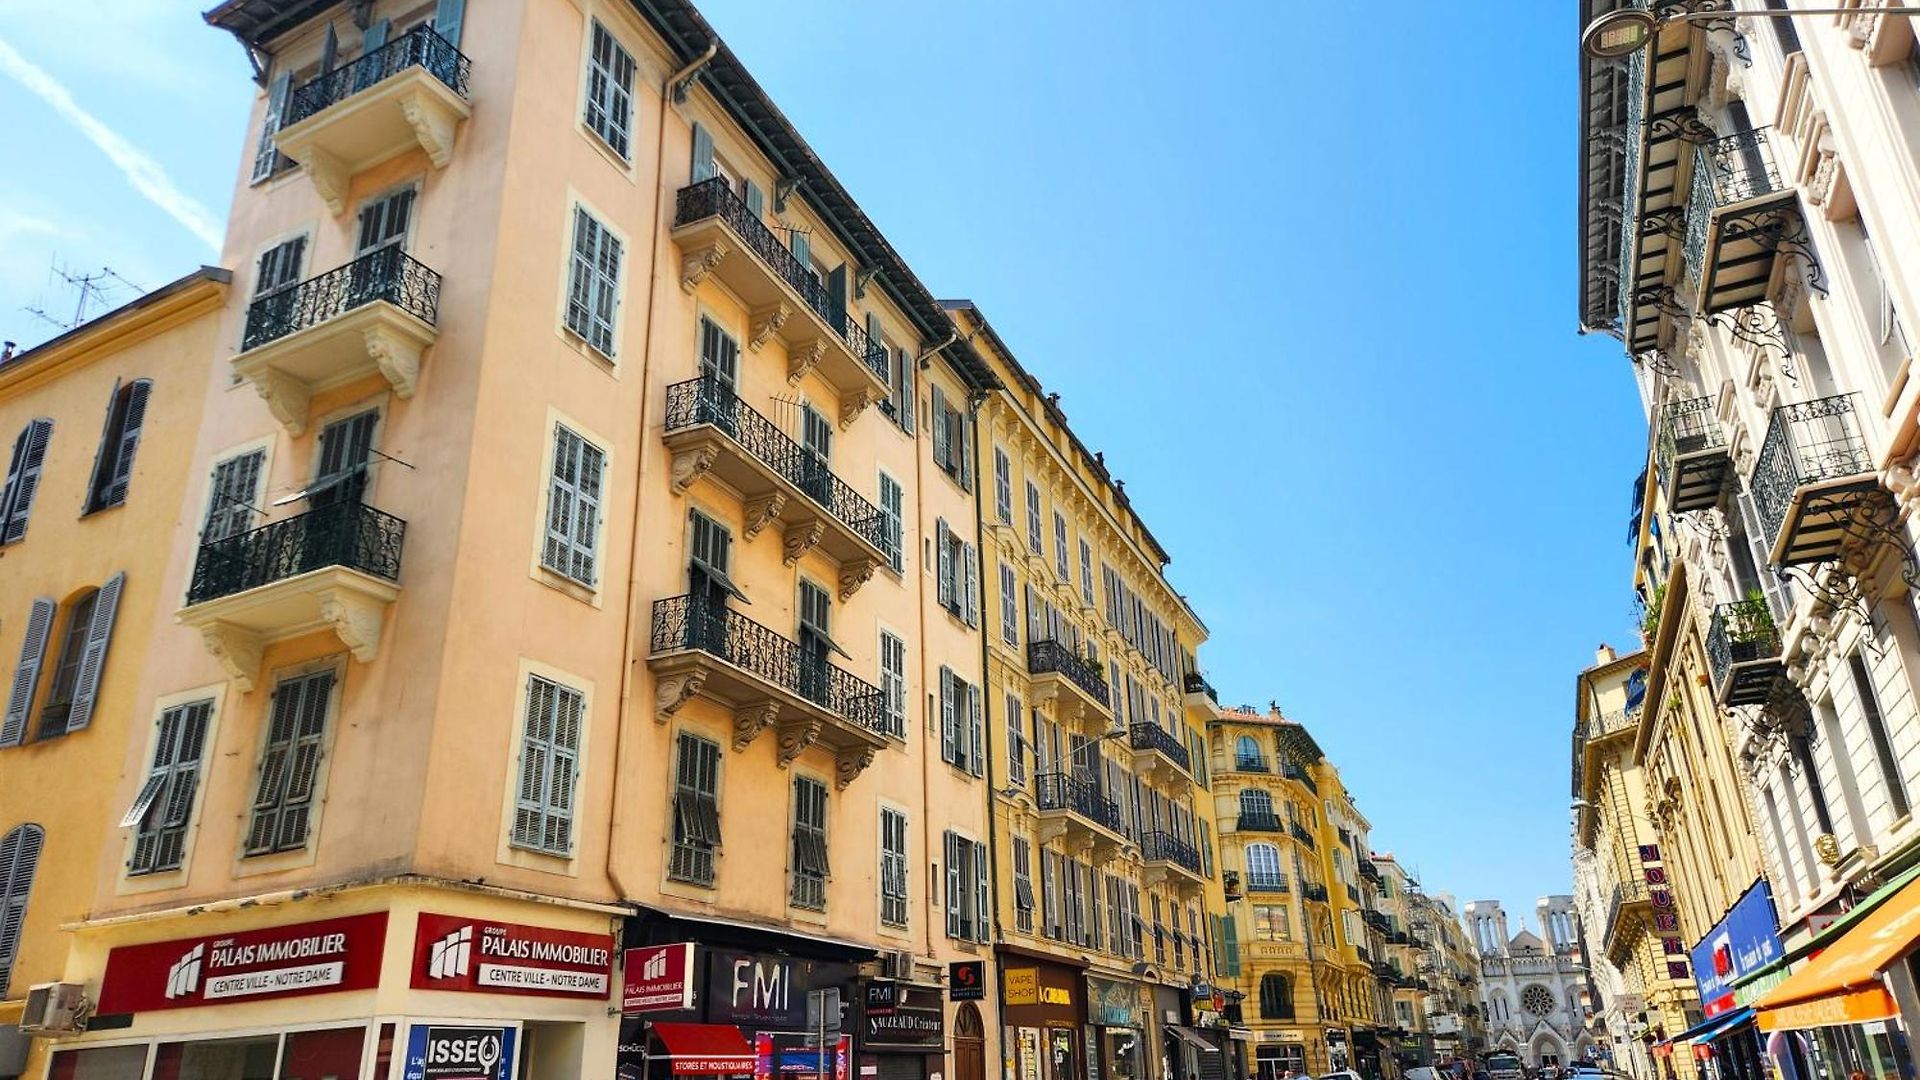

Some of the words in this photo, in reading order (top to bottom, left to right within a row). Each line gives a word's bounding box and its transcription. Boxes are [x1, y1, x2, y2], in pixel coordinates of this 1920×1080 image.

[209, 944, 255, 968] PALAIS
[256, 933, 346, 962] IMMOBILIER
[481, 936, 530, 958] PALAIS
[531, 941, 609, 967] IMMOBILIER
[213, 978, 245, 993] CENTRE
[245, 975, 268, 990] VILLE
[275, 971, 304, 988] NOTRE
[305, 967, 332, 983] DAME
[489, 968, 522, 983] CENTRE
[523, 971, 545, 985] VILLE
[551, 972, 577, 987] NOTRE
[578, 974, 600, 988] DAME
[733, 960, 789, 1010] FMI
[1008, 974, 1032, 985] VAPE
[869, 986, 891, 1000] FMI
[1008, 988, 1034, 998] SHOP
[675, 1062, 699, 1070] STORES
